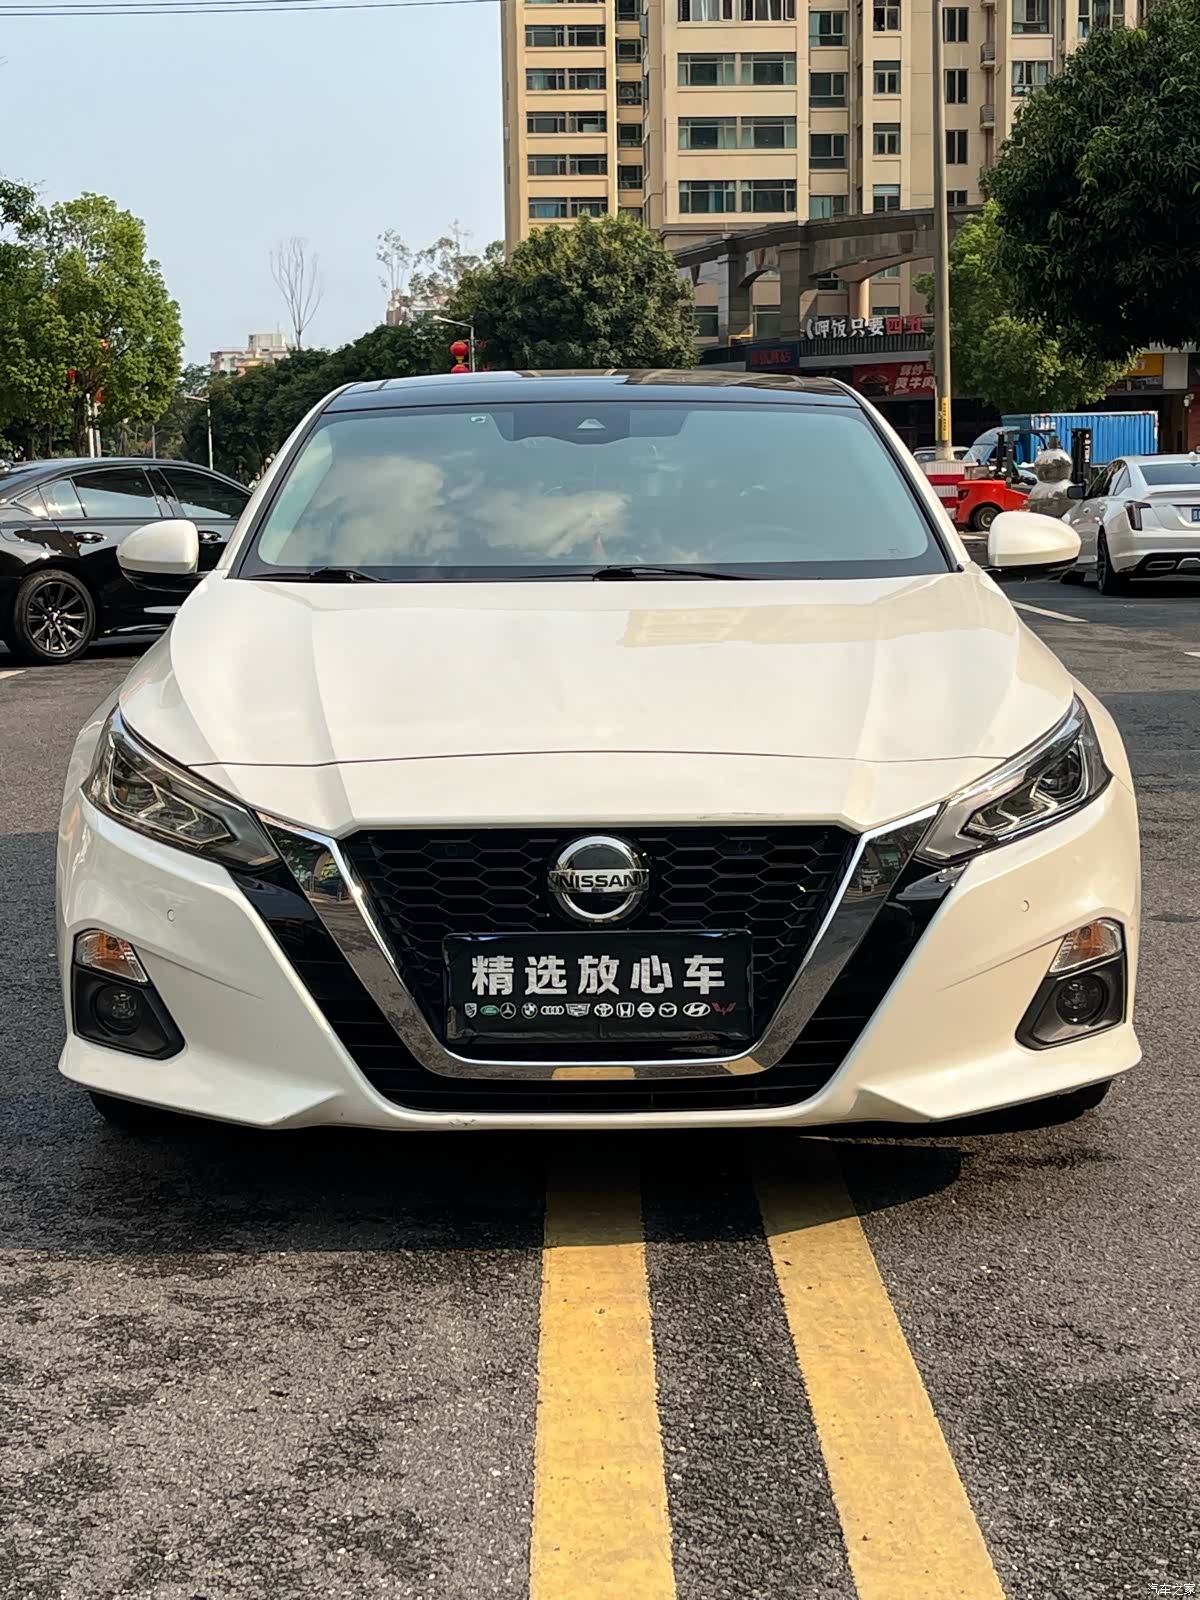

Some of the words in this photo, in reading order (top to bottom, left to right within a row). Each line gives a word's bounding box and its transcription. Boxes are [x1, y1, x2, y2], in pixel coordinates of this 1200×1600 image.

[559, 874, 639, 888] NISSAN
[472, 954, 726, 996] 精选放心车
